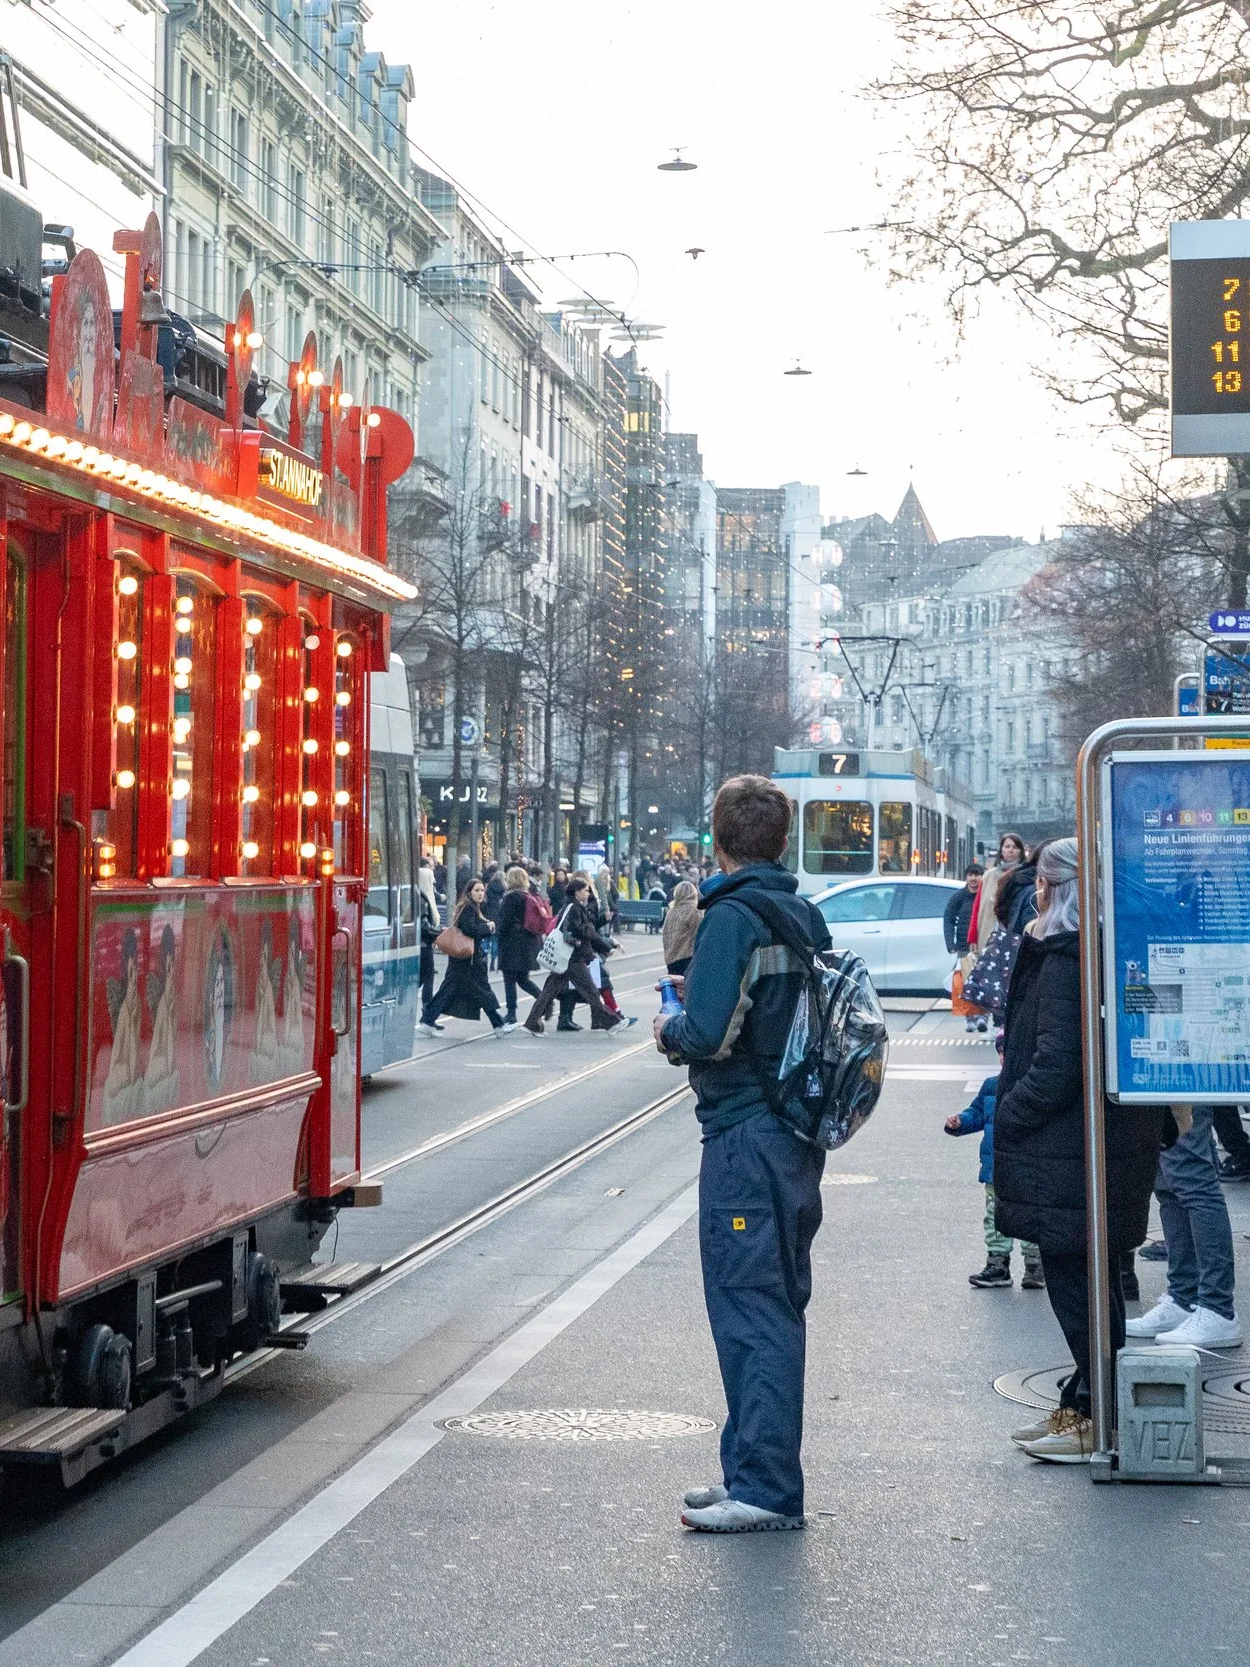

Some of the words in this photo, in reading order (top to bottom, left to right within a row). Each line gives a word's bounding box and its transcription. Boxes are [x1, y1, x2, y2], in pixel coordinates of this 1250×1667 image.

[1223, 278, 1240, 300] 7
[1223, 310, 1241, 332] 6
[1211, 341, 1239, 362] 11
[1212, 371, 1242, 393] 13
[269, 448, 324, 506] ST.ANNAHOF
[831, 754, 847, 774] 7
[1166, 813, 1173, 823] 4
[1200, 813, 1212, 822] 10
[1219, 812, 1229, 821] 11
[1237, 812, 1248, 821] 13
[1144, 834, 1170, 845] Neue
[1172, 832, 1250, 845] Linienführunge
[1127, 1419, 1194, 1462] VBZ
